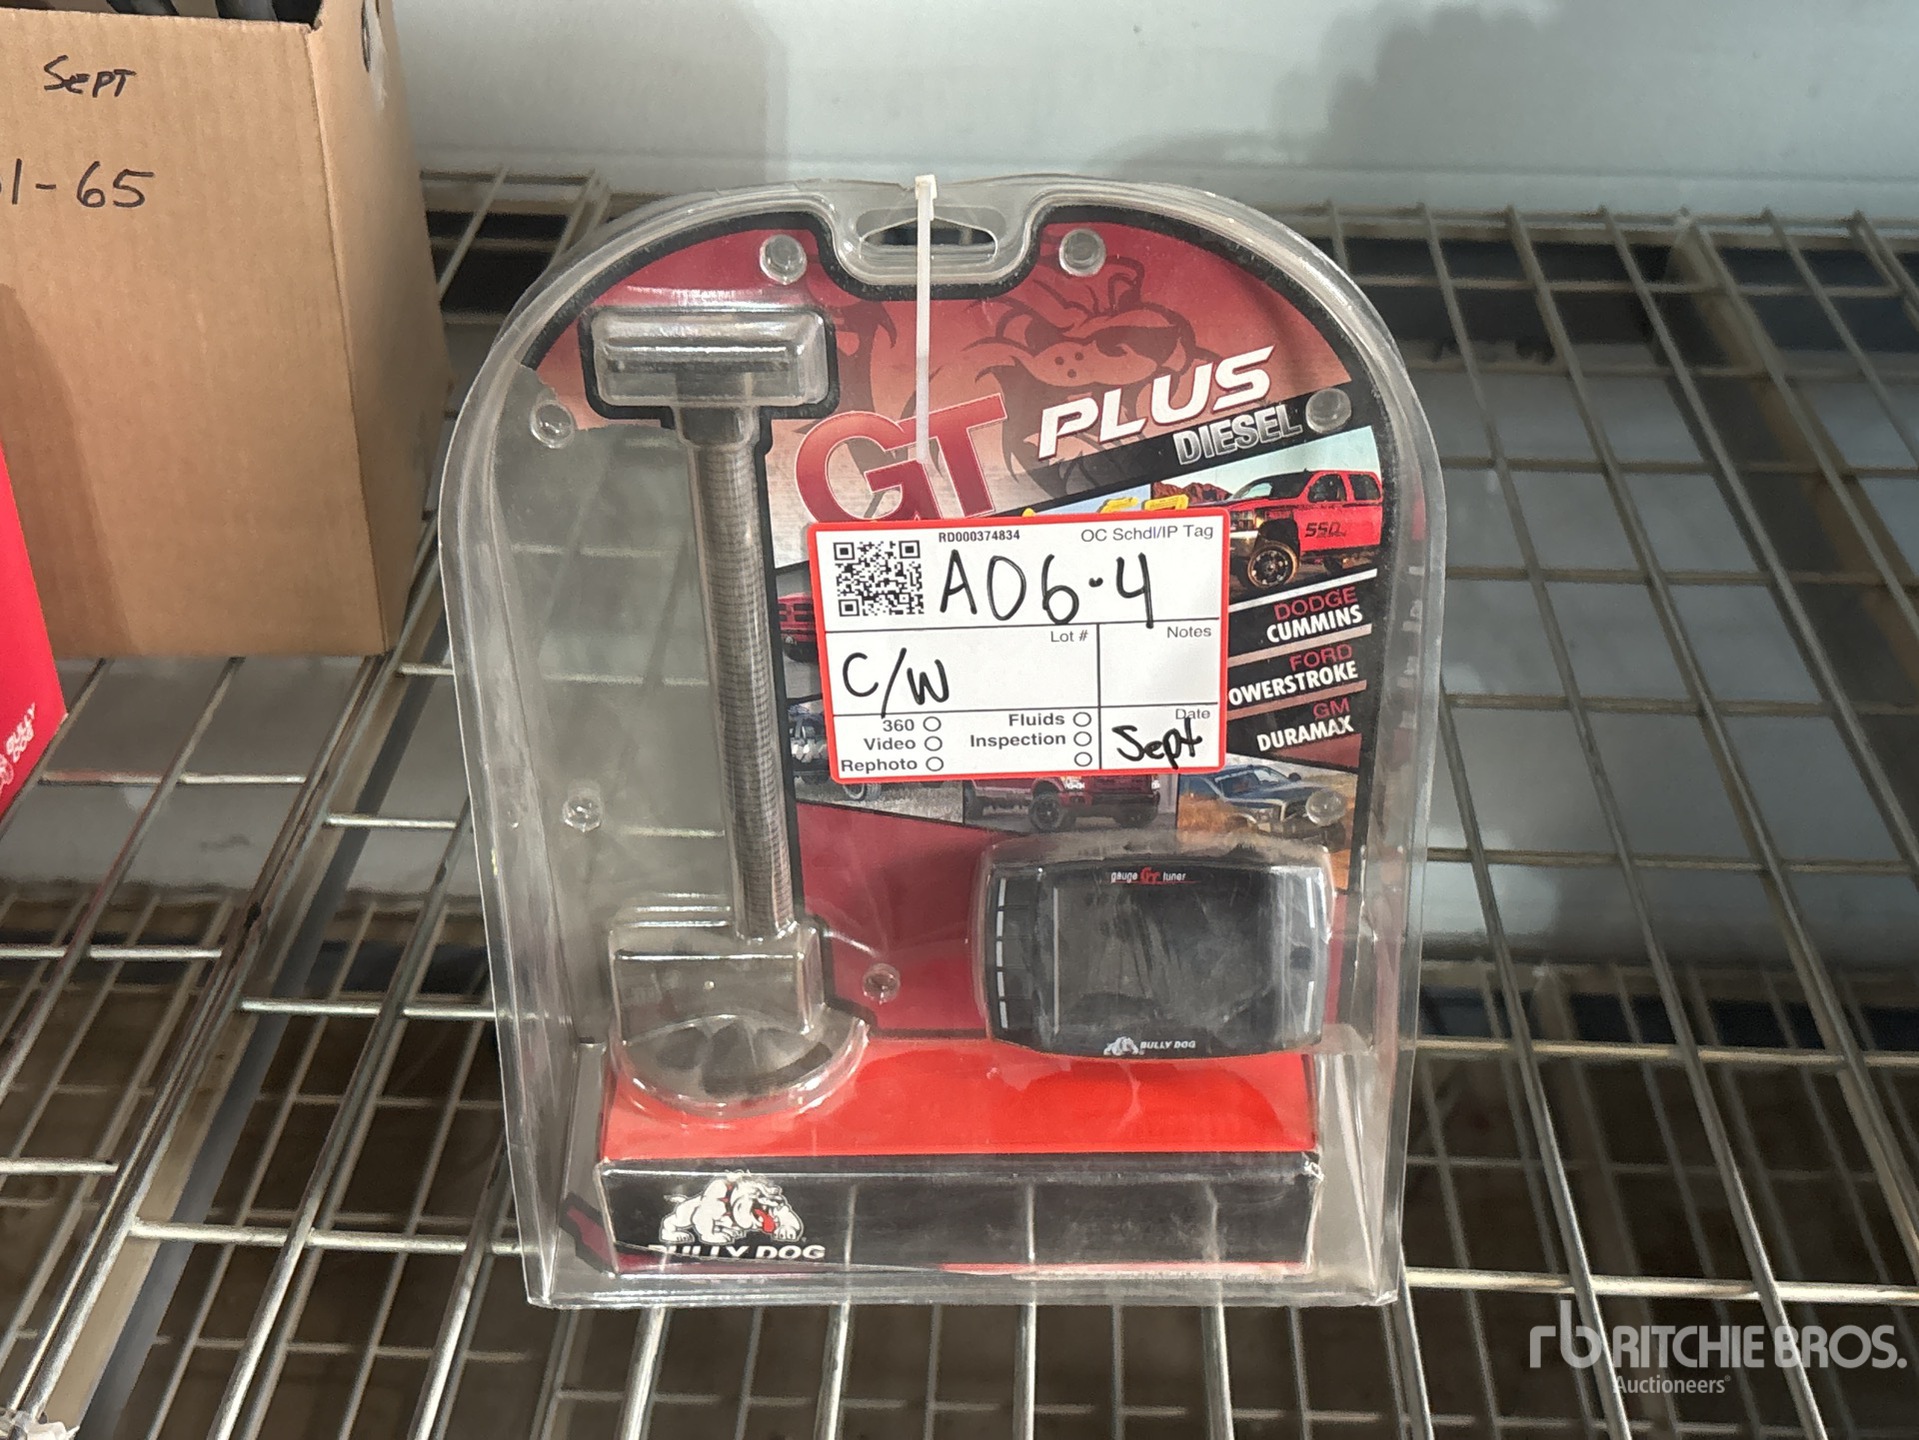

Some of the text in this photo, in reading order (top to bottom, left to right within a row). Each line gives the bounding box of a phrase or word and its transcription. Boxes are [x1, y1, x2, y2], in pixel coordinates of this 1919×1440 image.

[0, 158, 155, 209] 1-65
[795, 345, 1276, 522] GT PLUS
[1173, 404, 1302, 466] DIESEL
[938, 529, 1021, 543] RD000374834
[1080, 528, 1108, 543] OC
[1183, 524, 1214, 540] Tag
[1274, 586, 1358, 622] DODGE
[1167, 625, 1212, 639] Notes
[1266, 604, 1363, 643] CUMMINS
[1050, 629, 1088, 643] Lot #
[1289, 643, 1353, 672] FORD
[1229, 660, 1359, 706] OWERSTROKE
[1175, 708, 1211, 721] Date
[1313, 698, 1350, 719] GM
[882, 718, 915, 732] 360
[1009, 712, 1066, 727] Fluids
[970, 732, 1067, 751] Inspection
[1256, 716, 1354, 751] DURAMAX
[864, 736, 916, 751] Video
[1112, 717, 1202, 770] Sept
[841, 756, 918, 775] Rephoto
[1110, 871, 1138, 884] gauge
[1140, 1040, 1196, 1050] BULLY DOG
[755, 1244, 826, 1260] DOG
